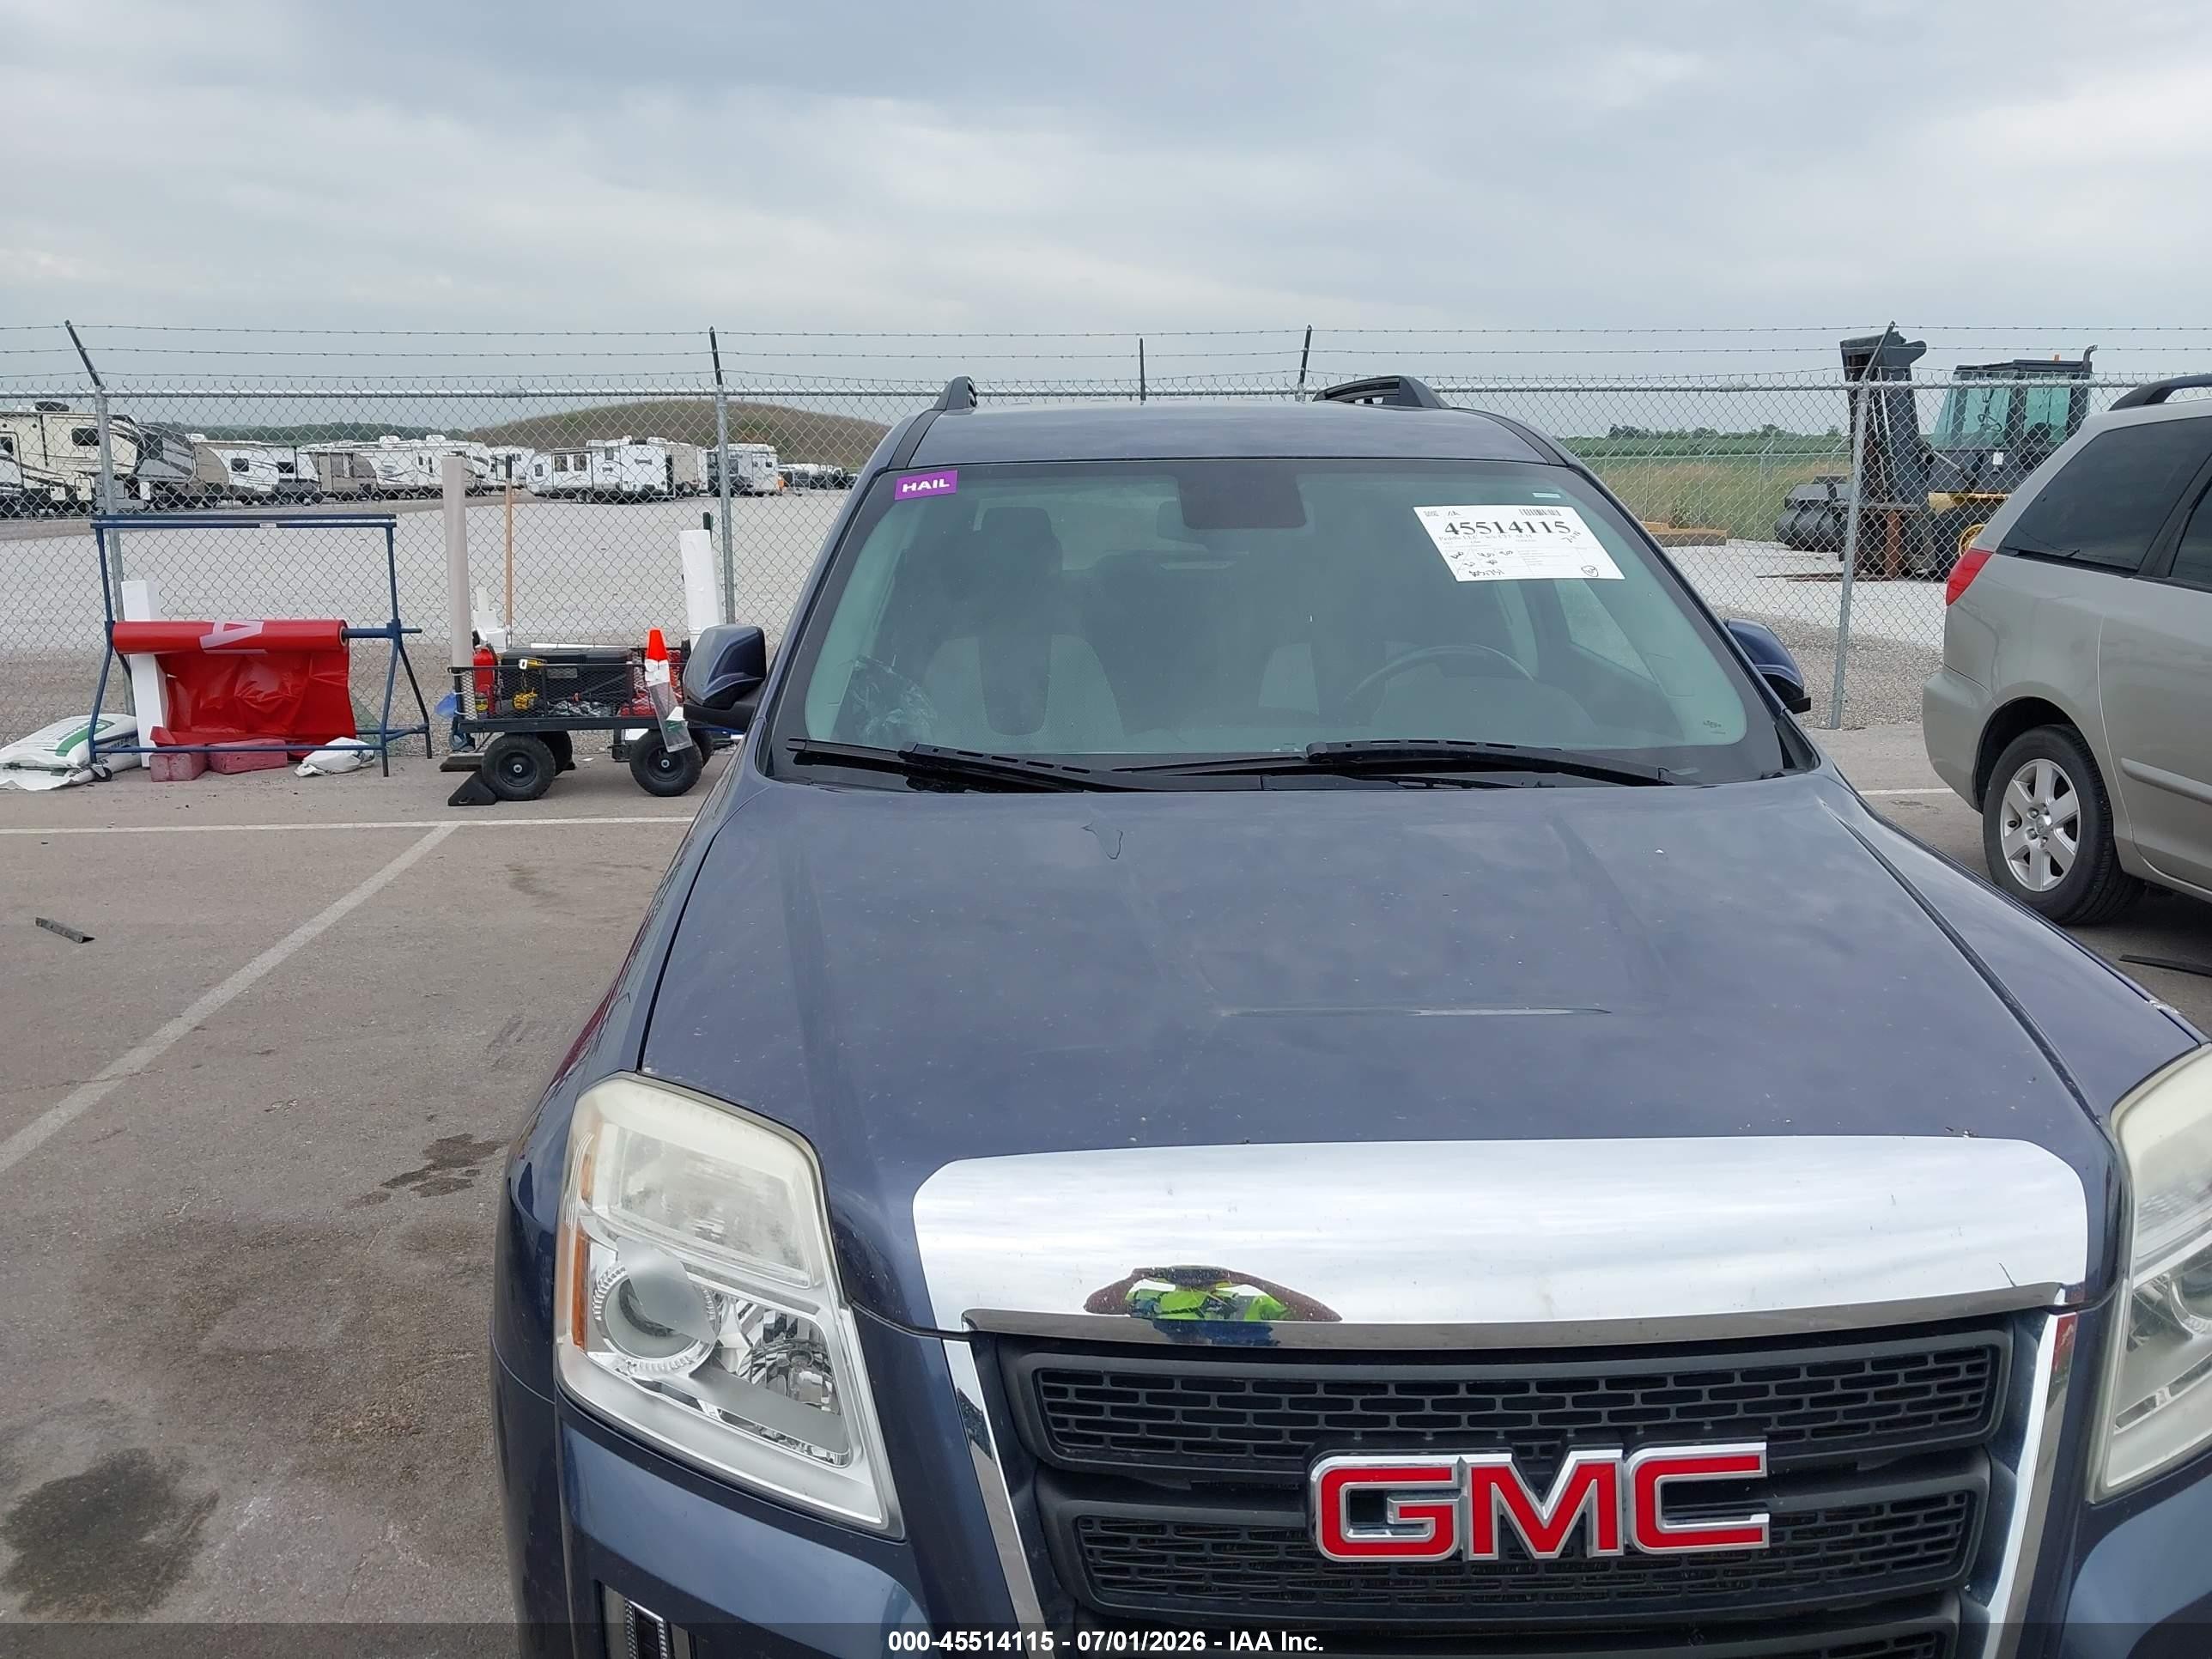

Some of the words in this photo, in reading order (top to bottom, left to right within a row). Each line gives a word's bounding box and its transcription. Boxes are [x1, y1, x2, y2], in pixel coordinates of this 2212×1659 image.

[902, 478, 950, 492] HAIL
[1444, 520, 1571, 535] 45514115
[1310, 1442, 1770, 1563] GMC
